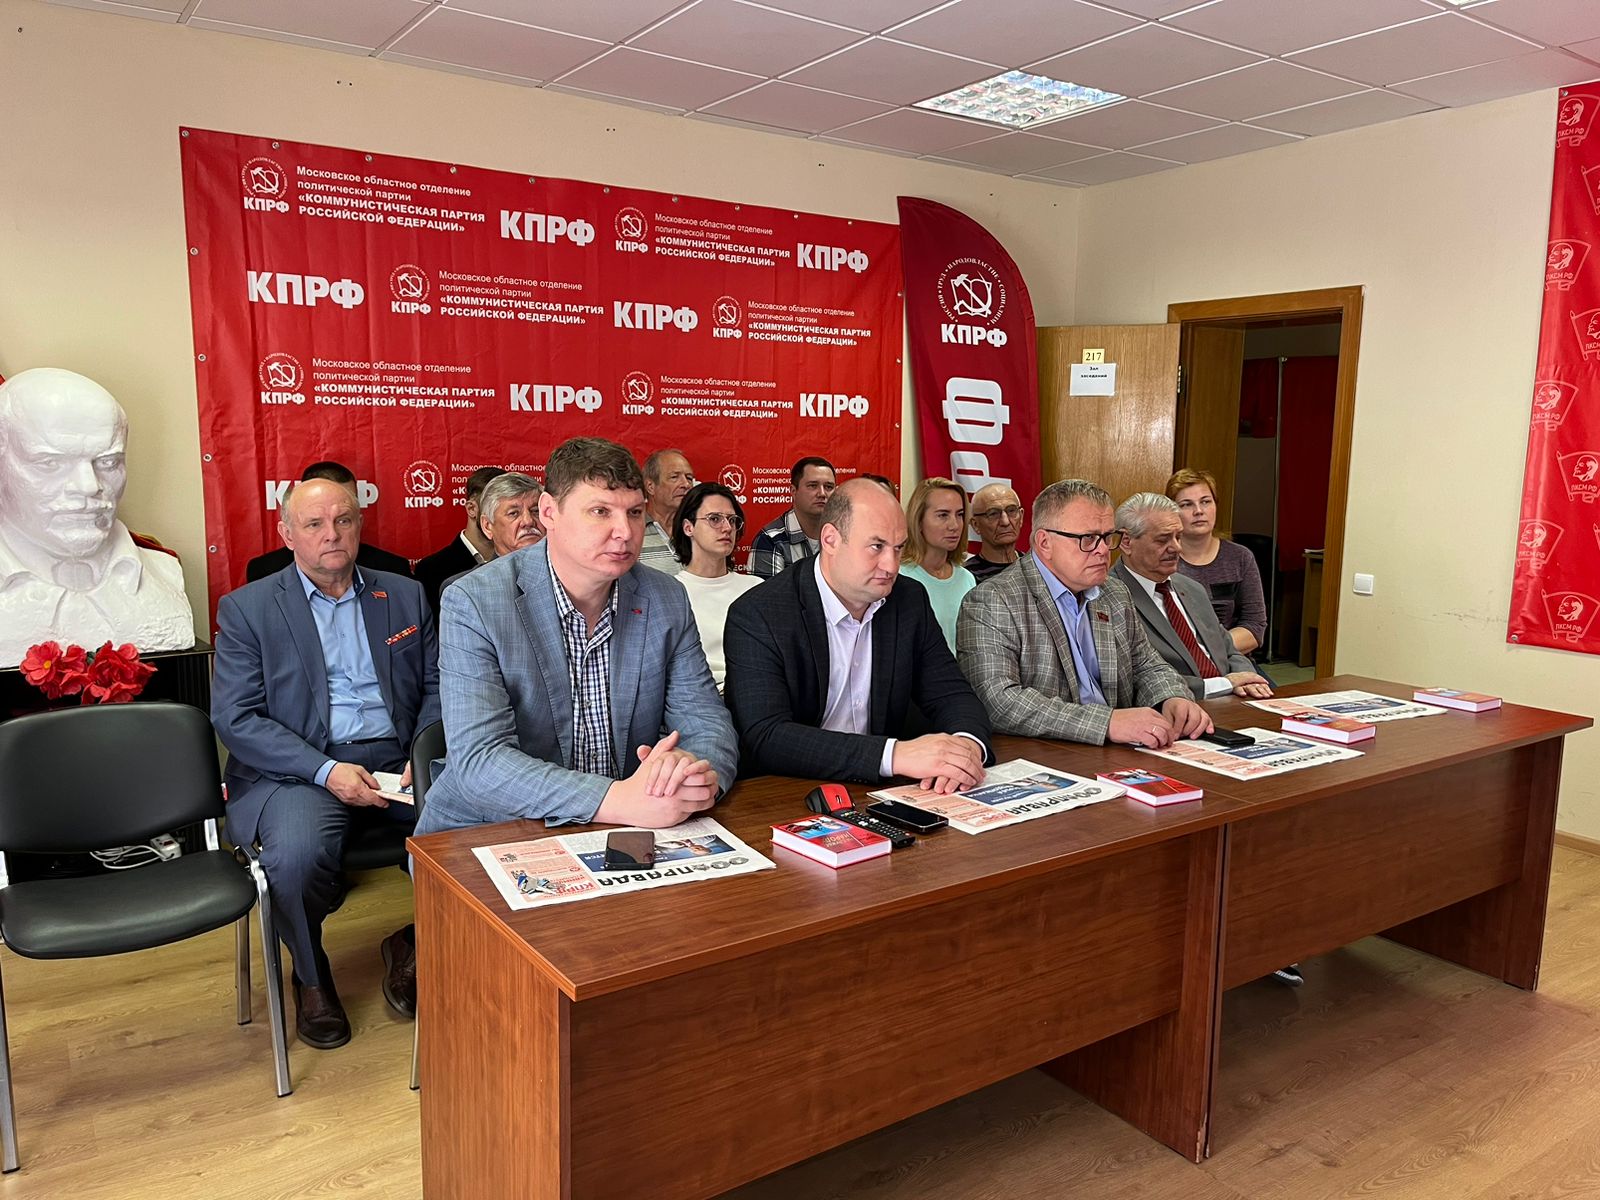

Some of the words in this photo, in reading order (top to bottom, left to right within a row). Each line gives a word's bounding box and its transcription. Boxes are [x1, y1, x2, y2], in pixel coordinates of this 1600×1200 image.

[296, 165, 361, 182] Московское
[364, 174, 418, 190] областное
[420, 183, 472, 197] отделение
[297, 181, 373, 197] политической
[375, 190, 412, 202] партии
[244, 196, 290, 213] КПРФ
[298, 193, 438, 217] «КОММУНИСТИЧЕСКАЯ
[440, 209, 486, 222] ПАРТИЯ
[299, 205, 384, 224] РОССИЙСКОЙ
[387, 216, 465, 232] ФЕДЕРАЦИИ»
[655, 212, 698, 227] Московское
[699, 218, 736, 231] областное
[738, 224, 773, 236] отделение
[500, 210, 596, 247] КПРФ
[655, 225, 704, 238] политической
[706, 231, 731, 241] партии
[615, 240, 648, 254] КПРФ
[656, 236, 756, 254] «КОММУНИСТИЧЕСКАЯ
[758, 246, 790, 258] ПАРТИЯ
[656, 246, 716, 260] РОССИЙСКОЙ
[718, 253, 776, 267] ФЕДЕРАЦИИ»
[797, 243, 869, 273] КПРФ
[439, 270, 491, 283] Московское
[494, 275, 538, 287] областное
[540, 280, 583, 291] отделение
[1564, 272, 1574, 280] РФ
[247, 270, 365, 309] КПРФ
[439, 284, 500, 296] политической
[502, 289, 532, 299] партии
[391, 300, 432, 314] КПРФ
[440, 294, 562, 312] «КОММУНИСТИЧЕСКАЯ
[564, 304, 604, 314] ПАРТИЯ
[748, 300, 788, 312] Московское
[788, 304, 822, 315] областное
[824, 308, 855, 318] отделение
[440, 306, 515, 320] РОССИЙСКОЙ
[517, 312, 586, 325] ФЕДЕРАЦИИ»
[614, 301, 698, 332] КПРФ
[748, 312, 794, 322] политической
[795, 316, 818, 324] партии
[713, 327, 743, 339] КПРФ
[748, 322, 839, 336] «КОММУНИСТИЧЕСКАЯ
[840, 328, 871, 338] ПАРТИЯ
[941, 324, 1008, 348] КПРФ
[748, 332, 804, 344] РОССИЙСКОЙ
[806, 336, 858, 346] ФЕДЕРАЦИИ»
[1085, 352, 1102, 361] 217
[312, 358, 370, 370] Московское
[372, 360, 422, 372] областное
[424, 364, 472, 374] отделение
[313, 372, 380, 382] политической
[382, 375, 415, 385] партии
[660, 376, 703, 386] Московское
[704, 378, 740, 388] областное
[742, 380, 776, 388] отделение
[260, 392, 306, 404] КПРФ
[314, 383, 448, 396] «КОММУНИСТИЧЕСКАЯ
[452, 387, 496, 397] ПАРТИЯ
[660, 386, 710, 396] политической
[711, 389, 735, 398] партии
[314, 394, 396, 407] РОССИЙСКОЙ
[400, 398, 476, 409] ФЕДЕРАЦИИ»
[510, 384, 603, 413] КПРФ
[661, 397, 758, 408] «КОММУНИСТИЧЕСКАЯ
[760, 400, 794, 409] ПАРТИЯ
[799, 393, 870, 418] КПРФ
[623, 404, 655, 415] КПРФ
[661, 406, 720, 417] РОССИЙСКОЙ
[722, 409, 778, 418] ФЕДЕРАЦИИ»
[451, 464, 503, 472] Моское
[265, 480, 379, 510] КФ
[1588, 484, 1598, 492] РФ
[404, 496, 444, 508] КПРФ
[752, 494, 792, 504] РОССИЙС
[1572, 624, 1582, 632] РФ
[597, 866, 694, 887] ПРАВДА
